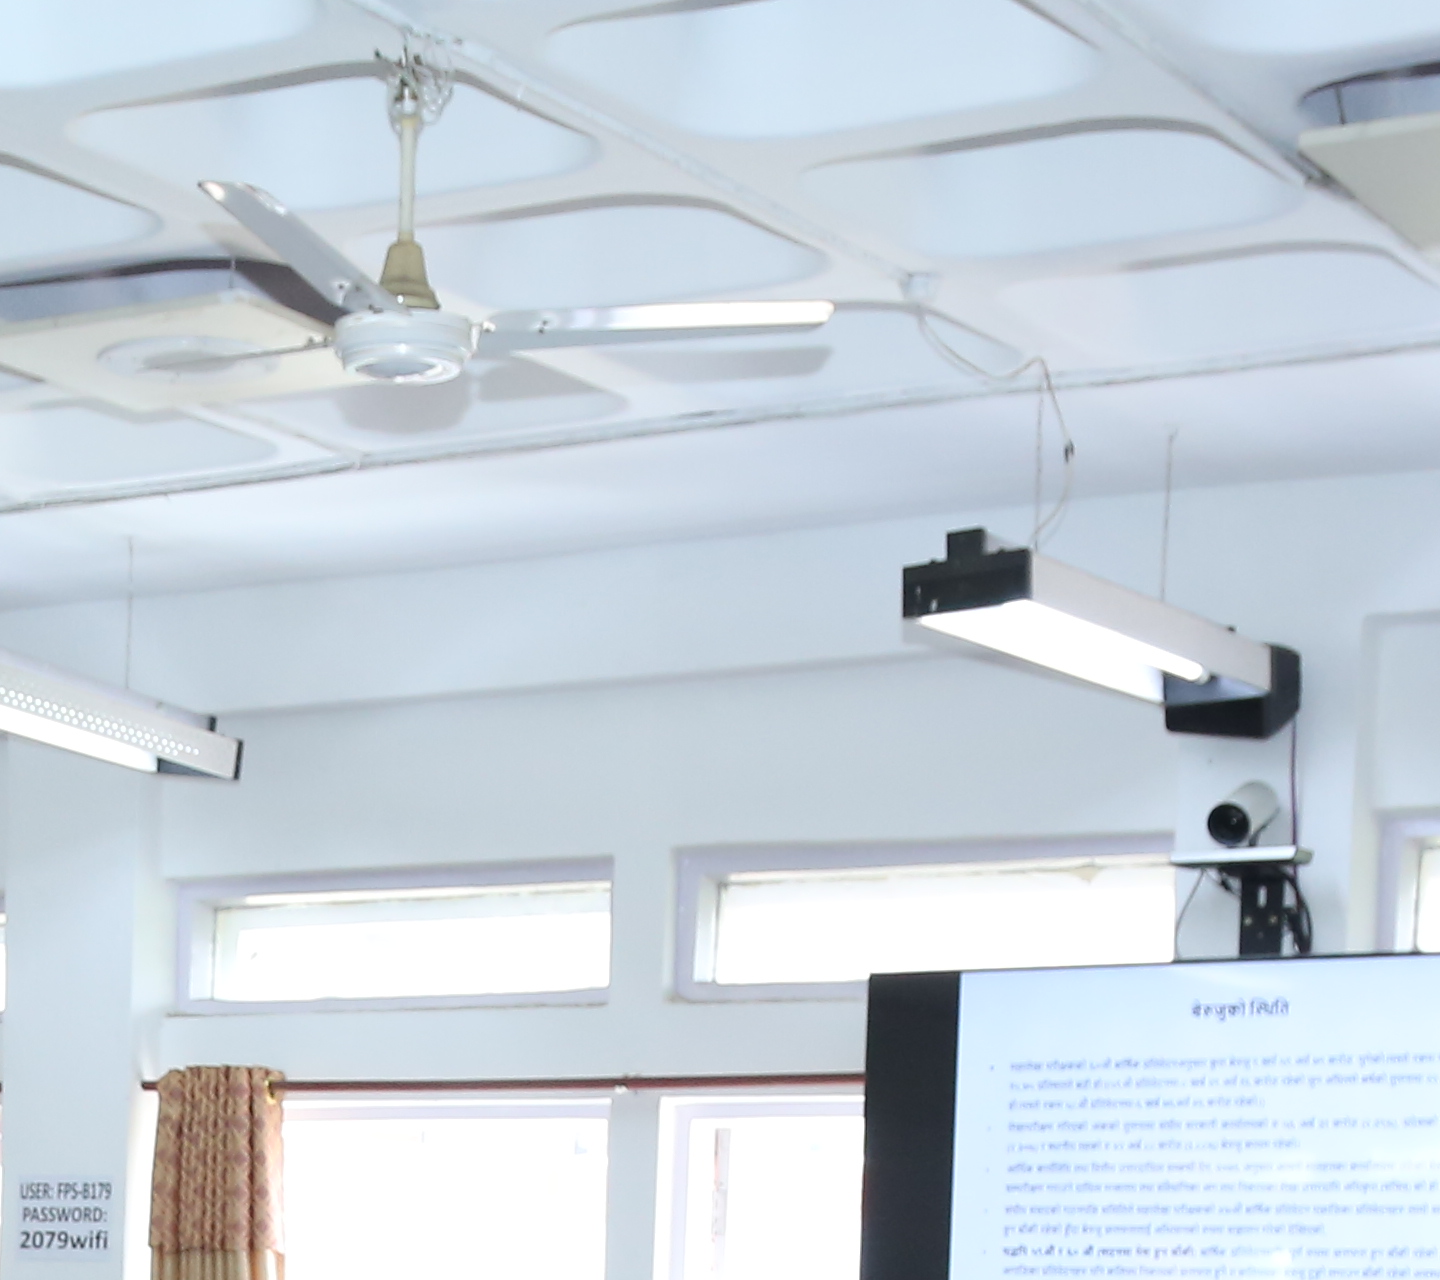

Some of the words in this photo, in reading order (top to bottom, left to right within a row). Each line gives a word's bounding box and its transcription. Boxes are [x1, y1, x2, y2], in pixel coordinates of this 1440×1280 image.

[1251, 996, 1289, 1015] स्थिति
[21, 1183, 54, 1199] USER:
[22, 1207, 108, 1222] PASSWORD:
[20, 1231, 108, 1249] 2079wifi
